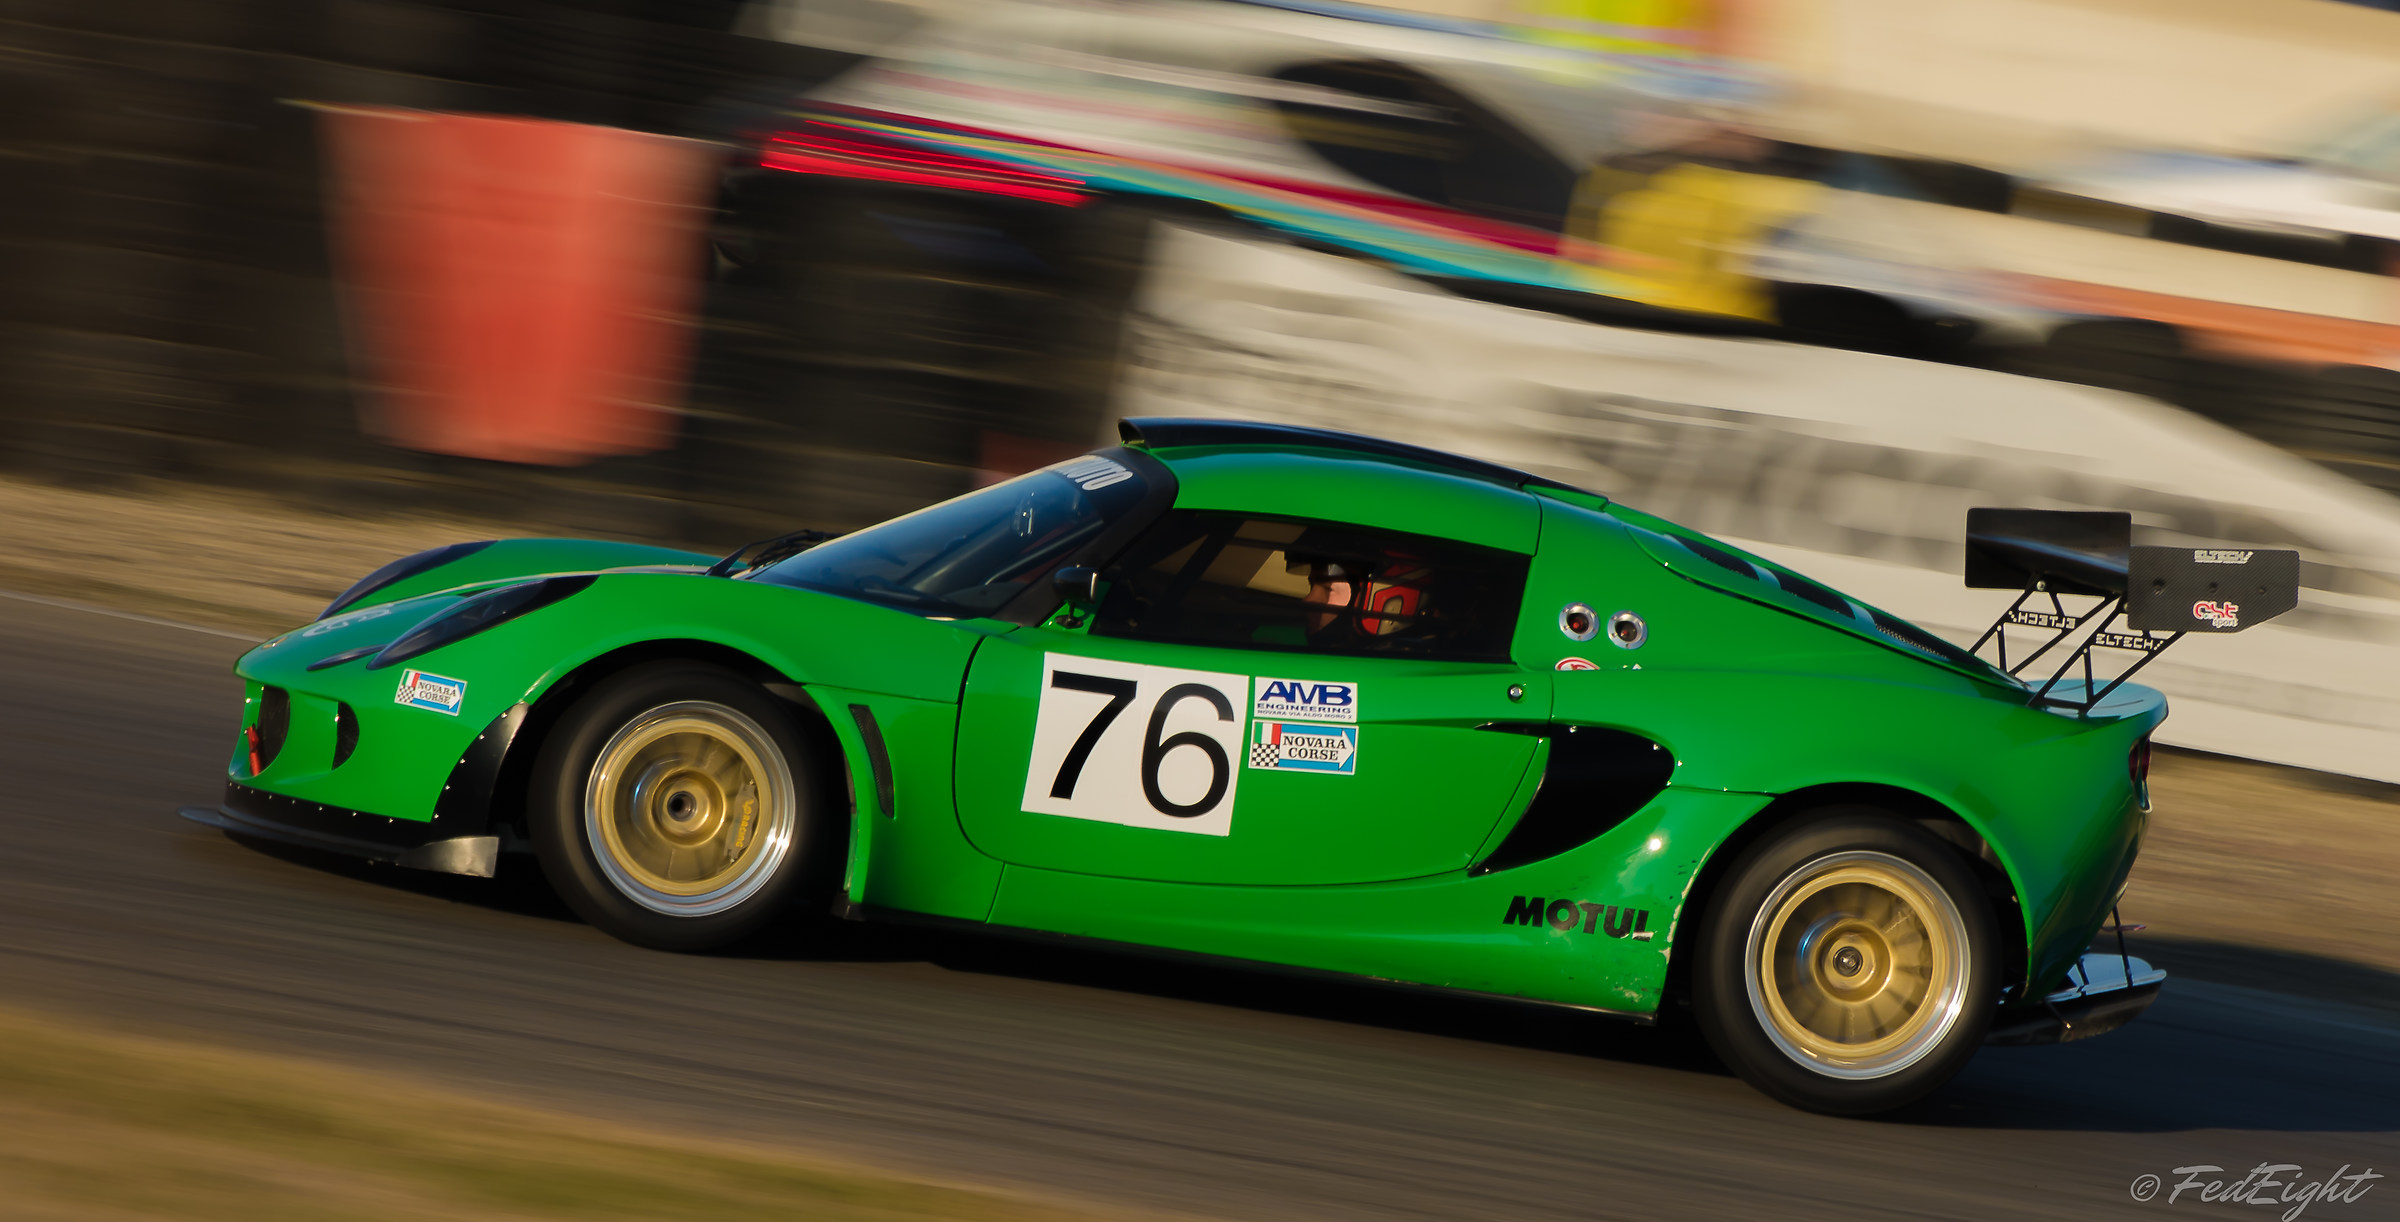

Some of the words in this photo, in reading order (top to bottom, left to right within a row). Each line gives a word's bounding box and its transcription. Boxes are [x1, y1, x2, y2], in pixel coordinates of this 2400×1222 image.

[2095, 633, 2154, 650] ELTECH
[418, 682, 456, 697] NOVARA
[1259, 681, 1352, 706] AMB
[419, 691, 450, 704] CORSE
[1257, 703, 1351, 714] ENGINEERING
[1049, 670, 1234, 818] 76
[1283, 736, 1347, 749] NOVARA
[1289, 748, 1339, 761] CORSE
[1502, 896, 1655, 943] MOTUL
